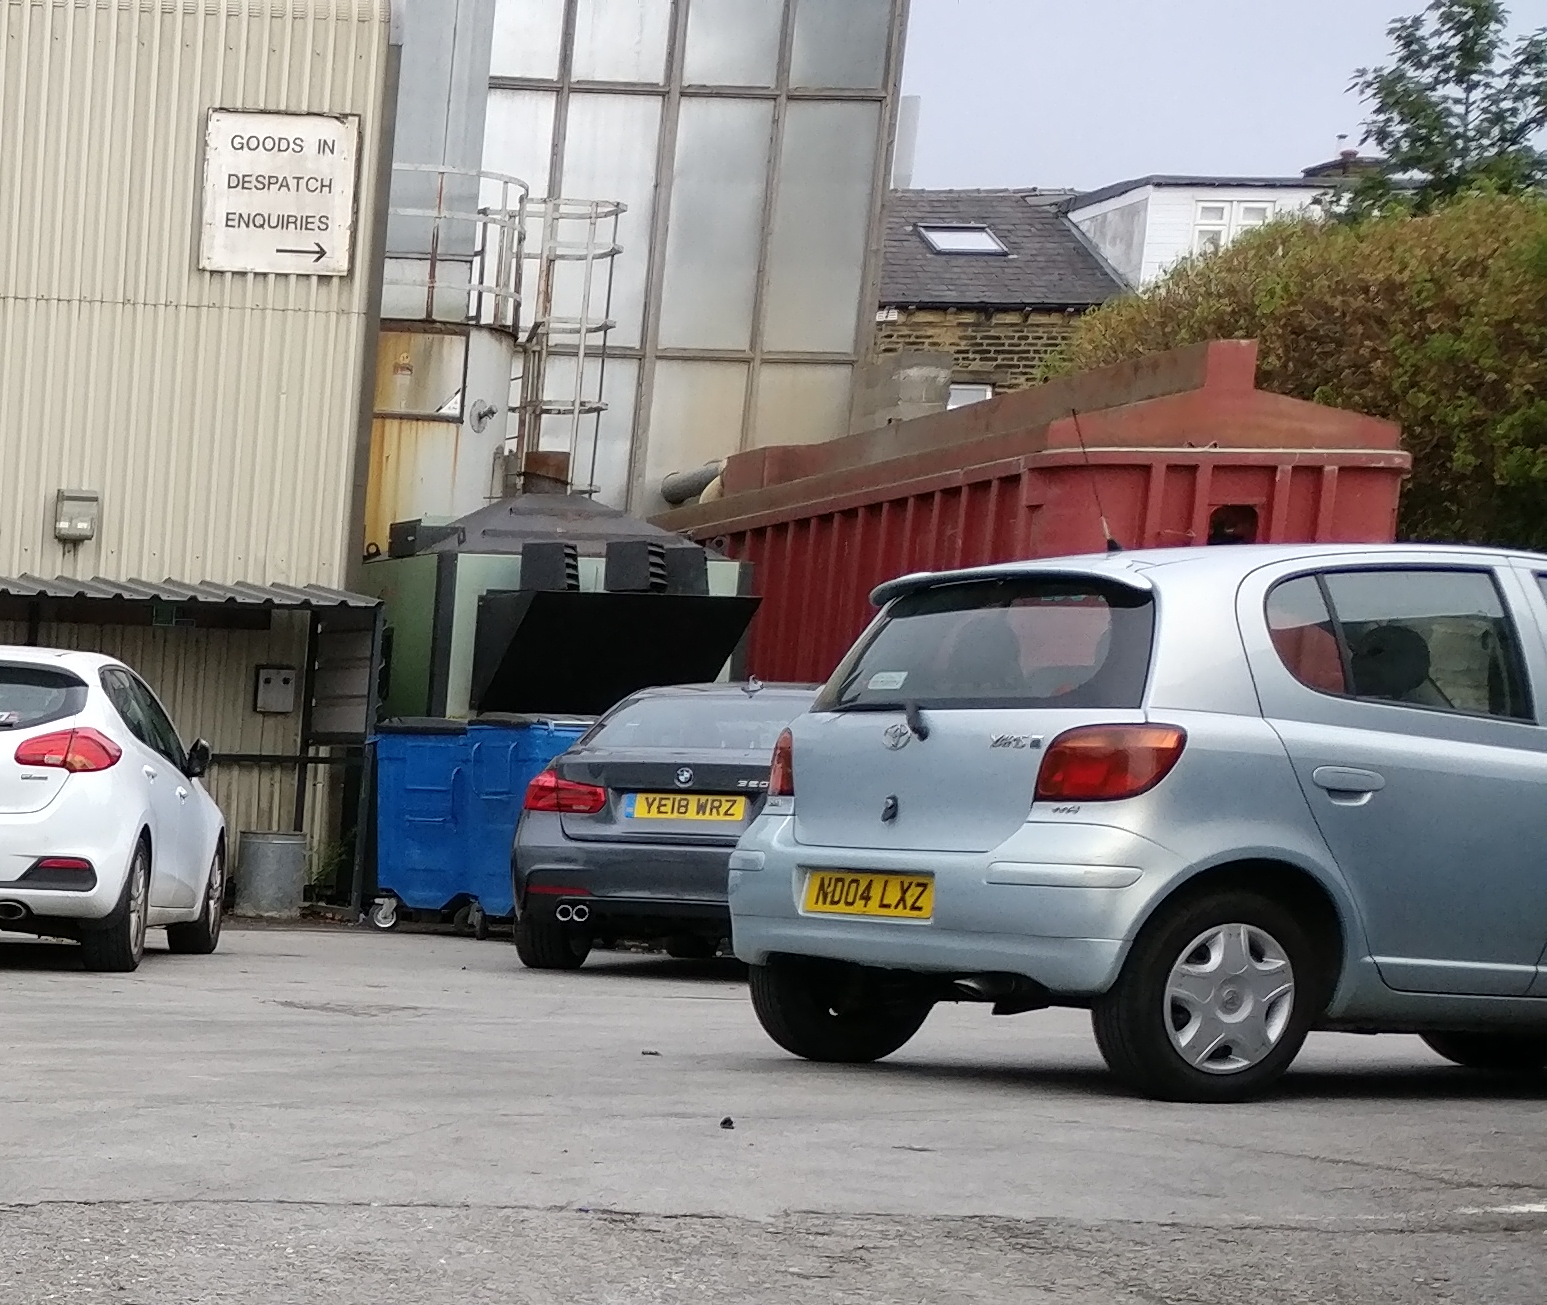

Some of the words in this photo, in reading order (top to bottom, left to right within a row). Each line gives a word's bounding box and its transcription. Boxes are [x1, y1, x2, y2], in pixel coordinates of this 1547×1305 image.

[230, 134, 305, 154] GOODS
[317, 138, 336, 155] IN
[227, 173, 333, 194] DESPATCH
[225, 212, 330, 232] ENQUIRIES
[644, 796, 690, 815] YE18
[695, 798, 737, 817] WRZ
[814, 876, 874, 908] ND04
[878, 879, 929, 911] LXZ
